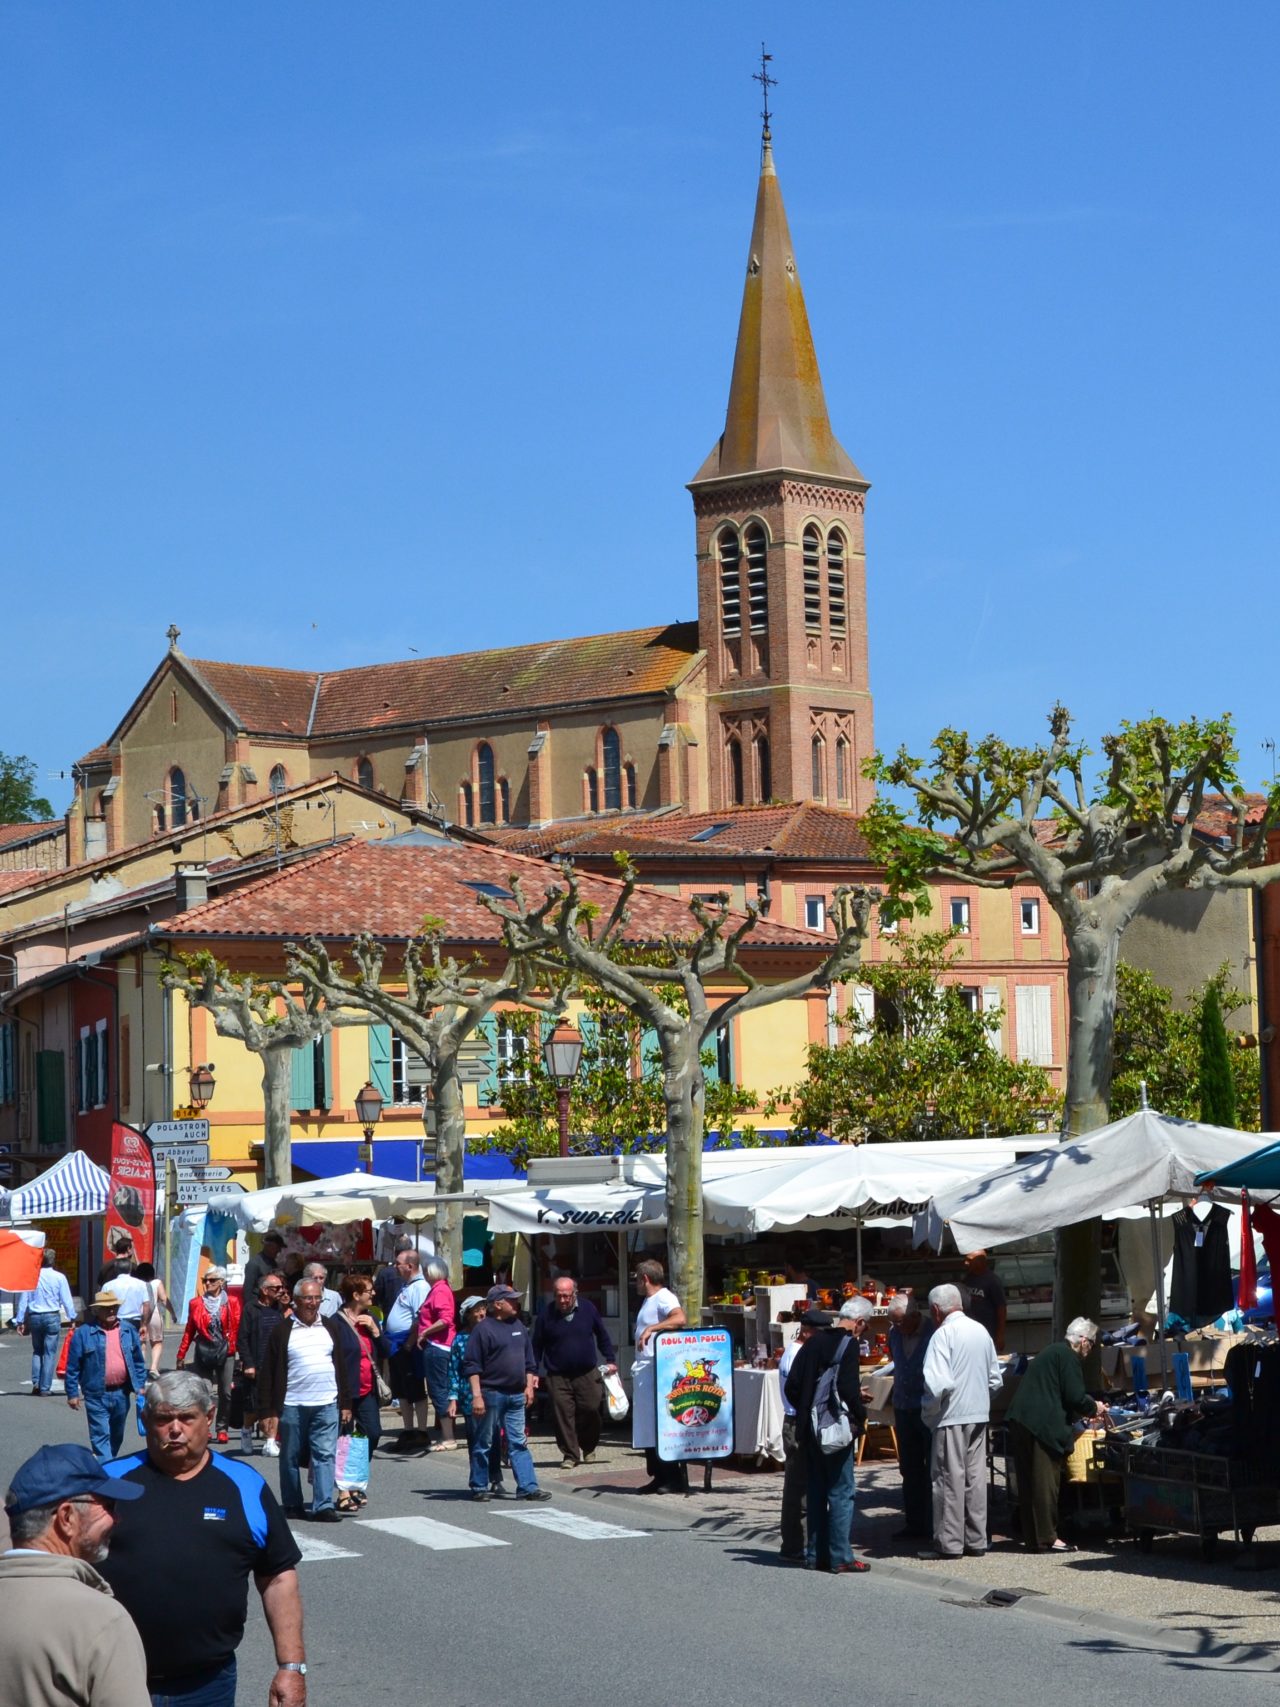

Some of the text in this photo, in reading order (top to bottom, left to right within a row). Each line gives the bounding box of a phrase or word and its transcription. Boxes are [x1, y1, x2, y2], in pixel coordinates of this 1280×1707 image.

[157, 1122, 206, 1132] POLASTRON
[184, 1131, 206, 1139] AUCH
[167, 1149, 195, 1157] Abbaye
[180, 1170, 223, 1178] endarmerie
[558, 1210, 644, 1225] SUDERIE
[701, 1334, 725, 1342] POULE
